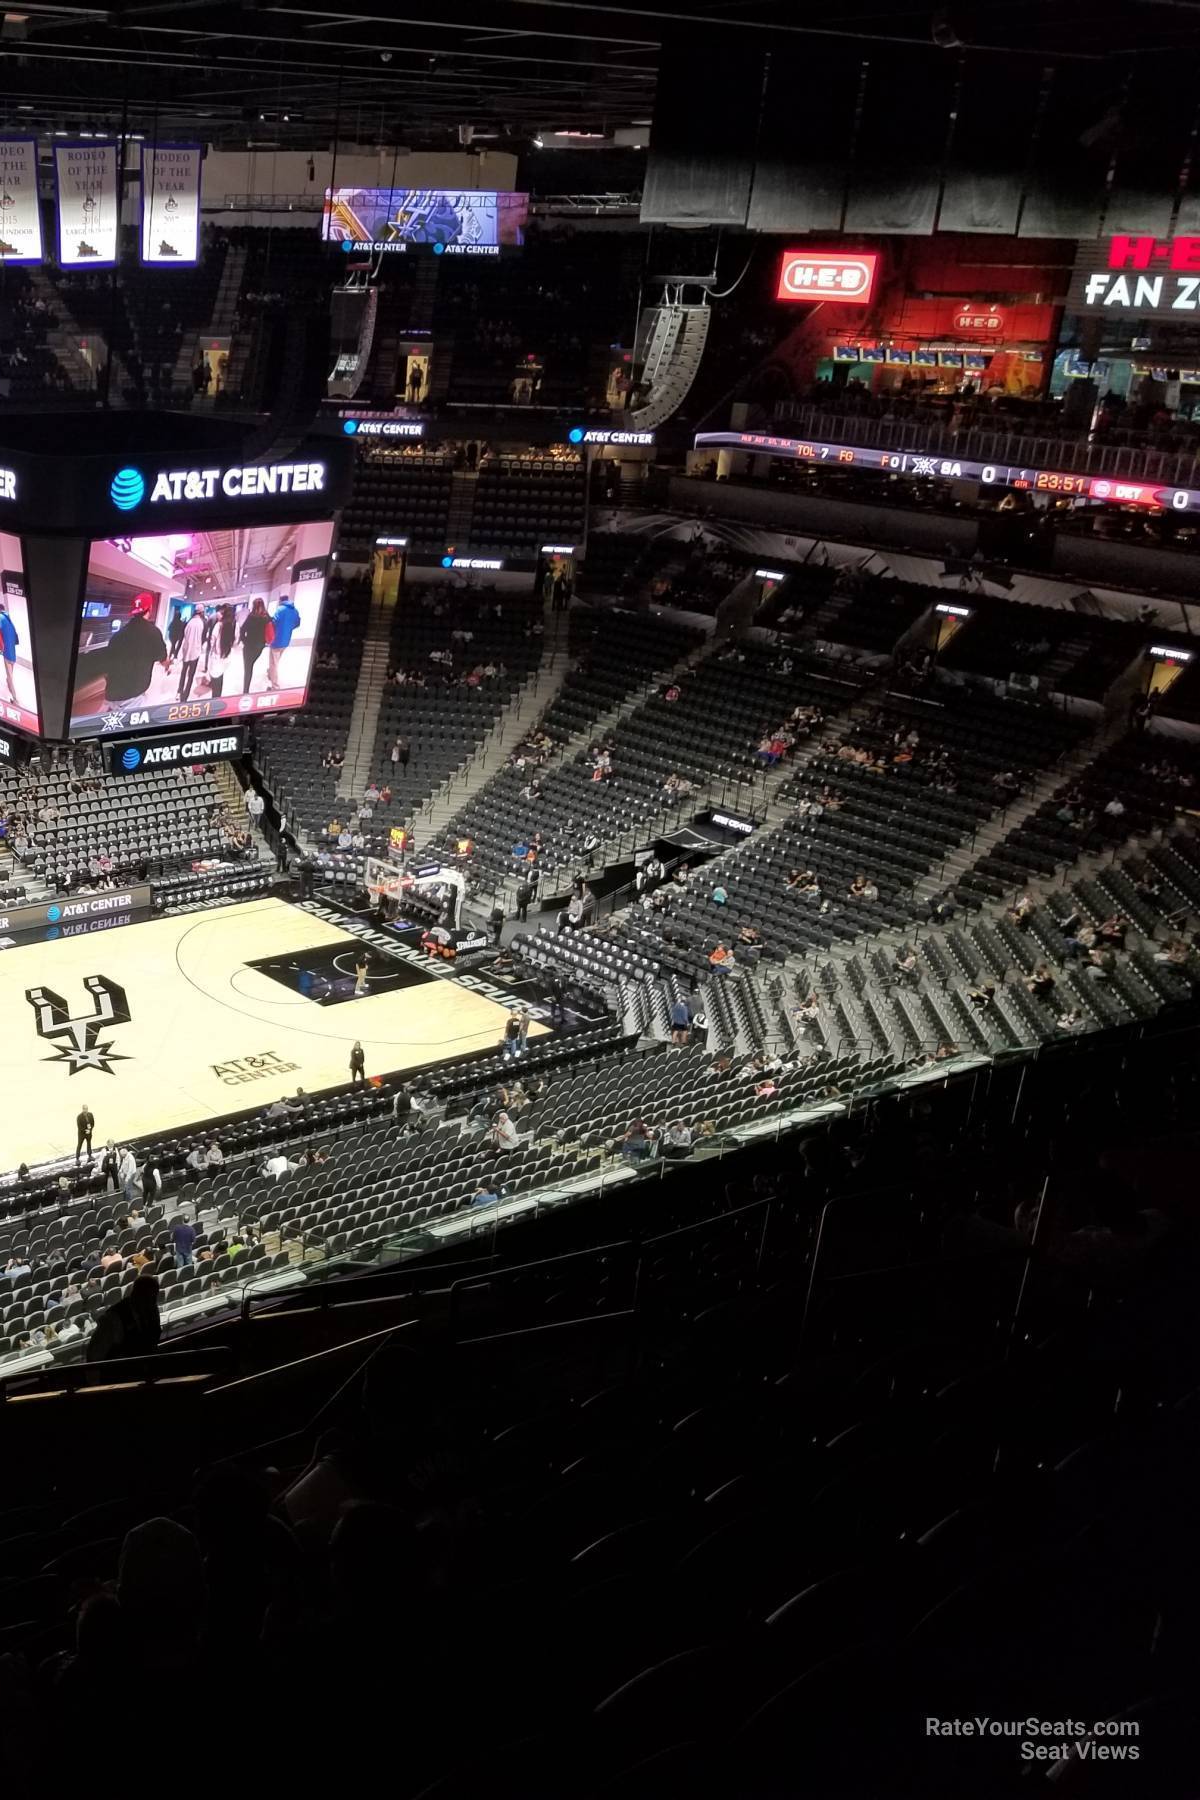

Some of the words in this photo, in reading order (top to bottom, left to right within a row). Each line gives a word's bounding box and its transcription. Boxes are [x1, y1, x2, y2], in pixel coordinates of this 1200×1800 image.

[68, 151, 106, 161] RODEO
[154, 153, 190, 162] RODEO
[3, 161, 27, 171] THE
[68, 167, 82, 176] OF
[86, 166, 108, 175] THE
[169, 168, 192, 176] THE
[75, 181, 102, 191] YEAR
[159, 182, 185, 191] YEAR
[445, 245, 466, 253] AT&T
[467, 246, 500, 254] CENTER
[1085, 274, 1164, 308] FAN
[357, 423, 382, 434] AT&T
[383, 424, 423, 435] CENTER
[583, 432, 611, 442] AT&T
[611, 432, 653, 444] CENTER
[797, 444, 815, 457] TOL
[820, 448, 830, 459] 7
[839, 450, 854, 462] FG
[890, 456, 900, 468] 0
[940, 462, 962, 477] SA
[982, 466, 996, 482] 0
[150, 470, 220, 502] AT&T
[222, 463, 325, 497] CENTER
[1037, 474, 1086, 493] 23:51
[1172, 491, 1189, 509] 0
[129, 710, 150, 726] SA
[168, 702, 212, 720] 23:51
[143, 744, 180, 764] AT&T
[182, 736, 238, 758] CENTER
[62, 904, 91, 918] AT&T
[92, 894, 132, 912] CENTER
[299, 900, 346, 924] SAN
[338, 921, 455, 975] ANTONIO
[208, 1051, 284, 1077] AT&T
[223, 1062, 302, 1086] CENTER
